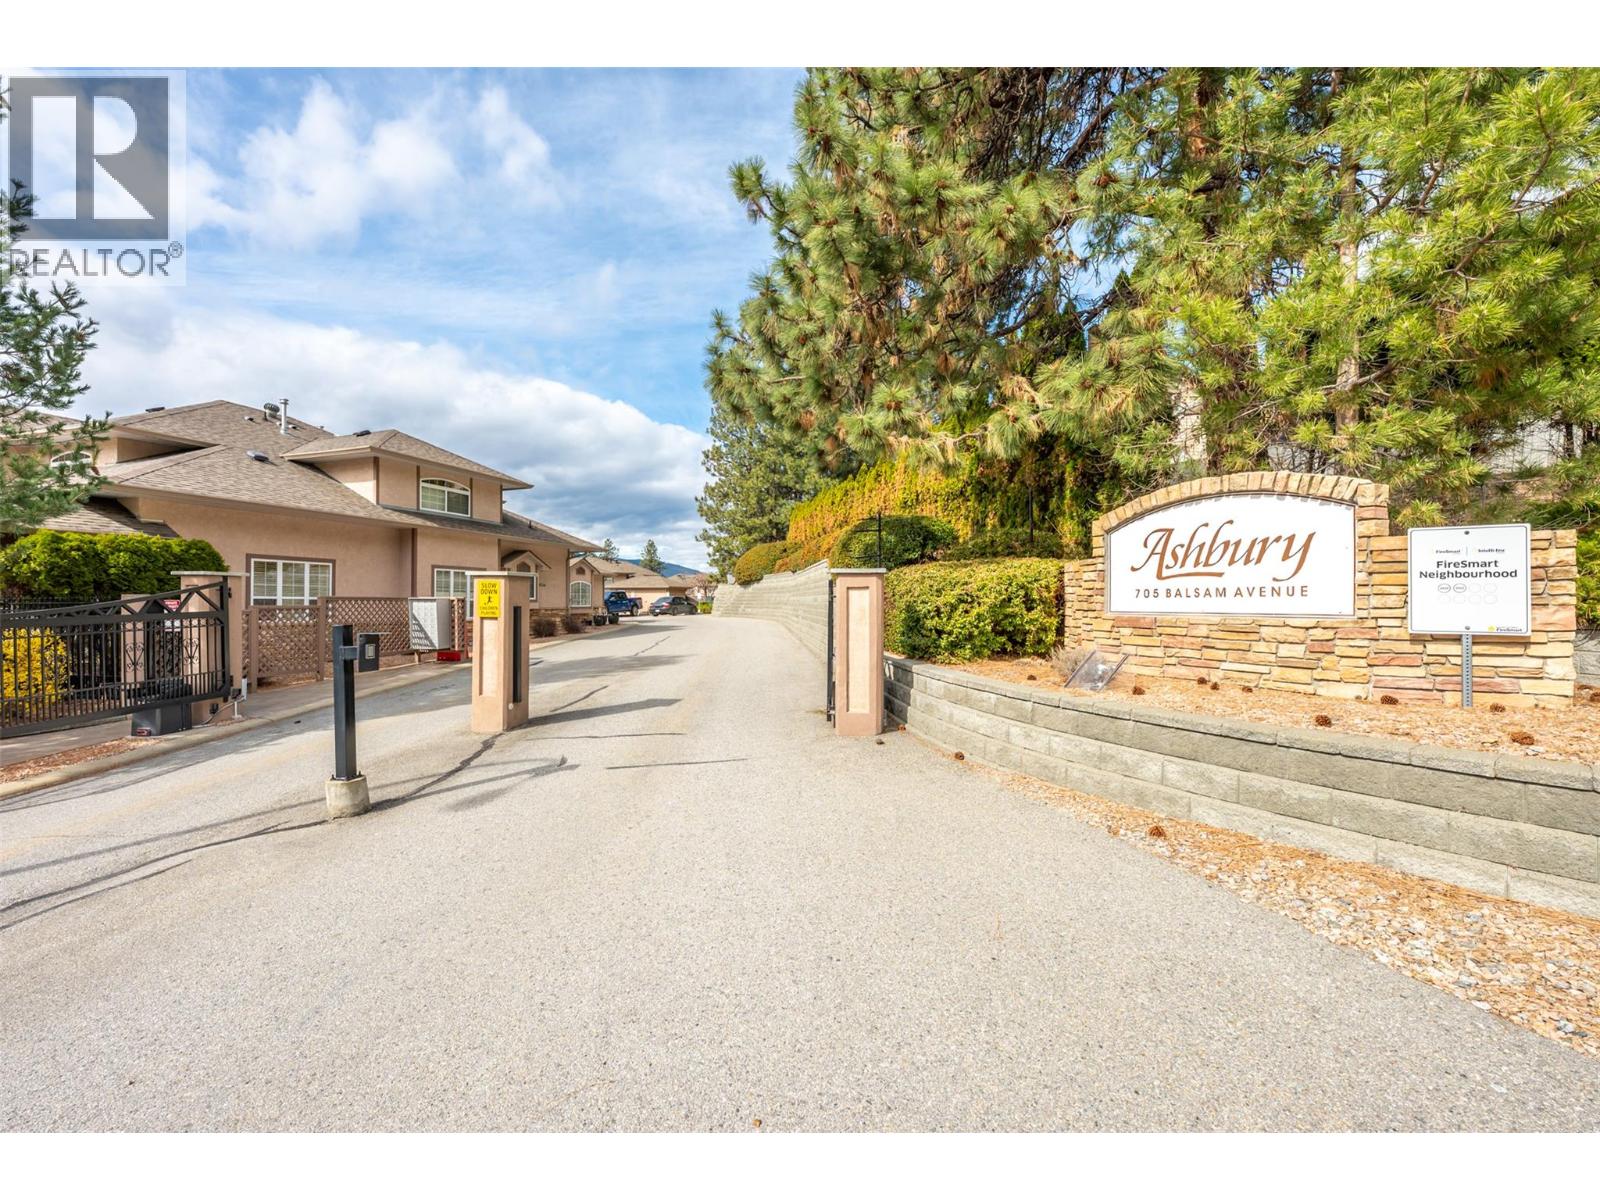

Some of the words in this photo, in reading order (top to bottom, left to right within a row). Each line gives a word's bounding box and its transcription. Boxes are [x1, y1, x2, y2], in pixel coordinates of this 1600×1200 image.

[1130, 519, 1317, 582] Ashbury
[1436, 560, 1500, 569] FireSmart
[1419, 569, 1518, 580] Neighbourhood
[1135, 588, 1160, 599] 705
[1165, 586, 1228, 599] BALSAM
[1233, 585, 1309, 598] AVENUE
